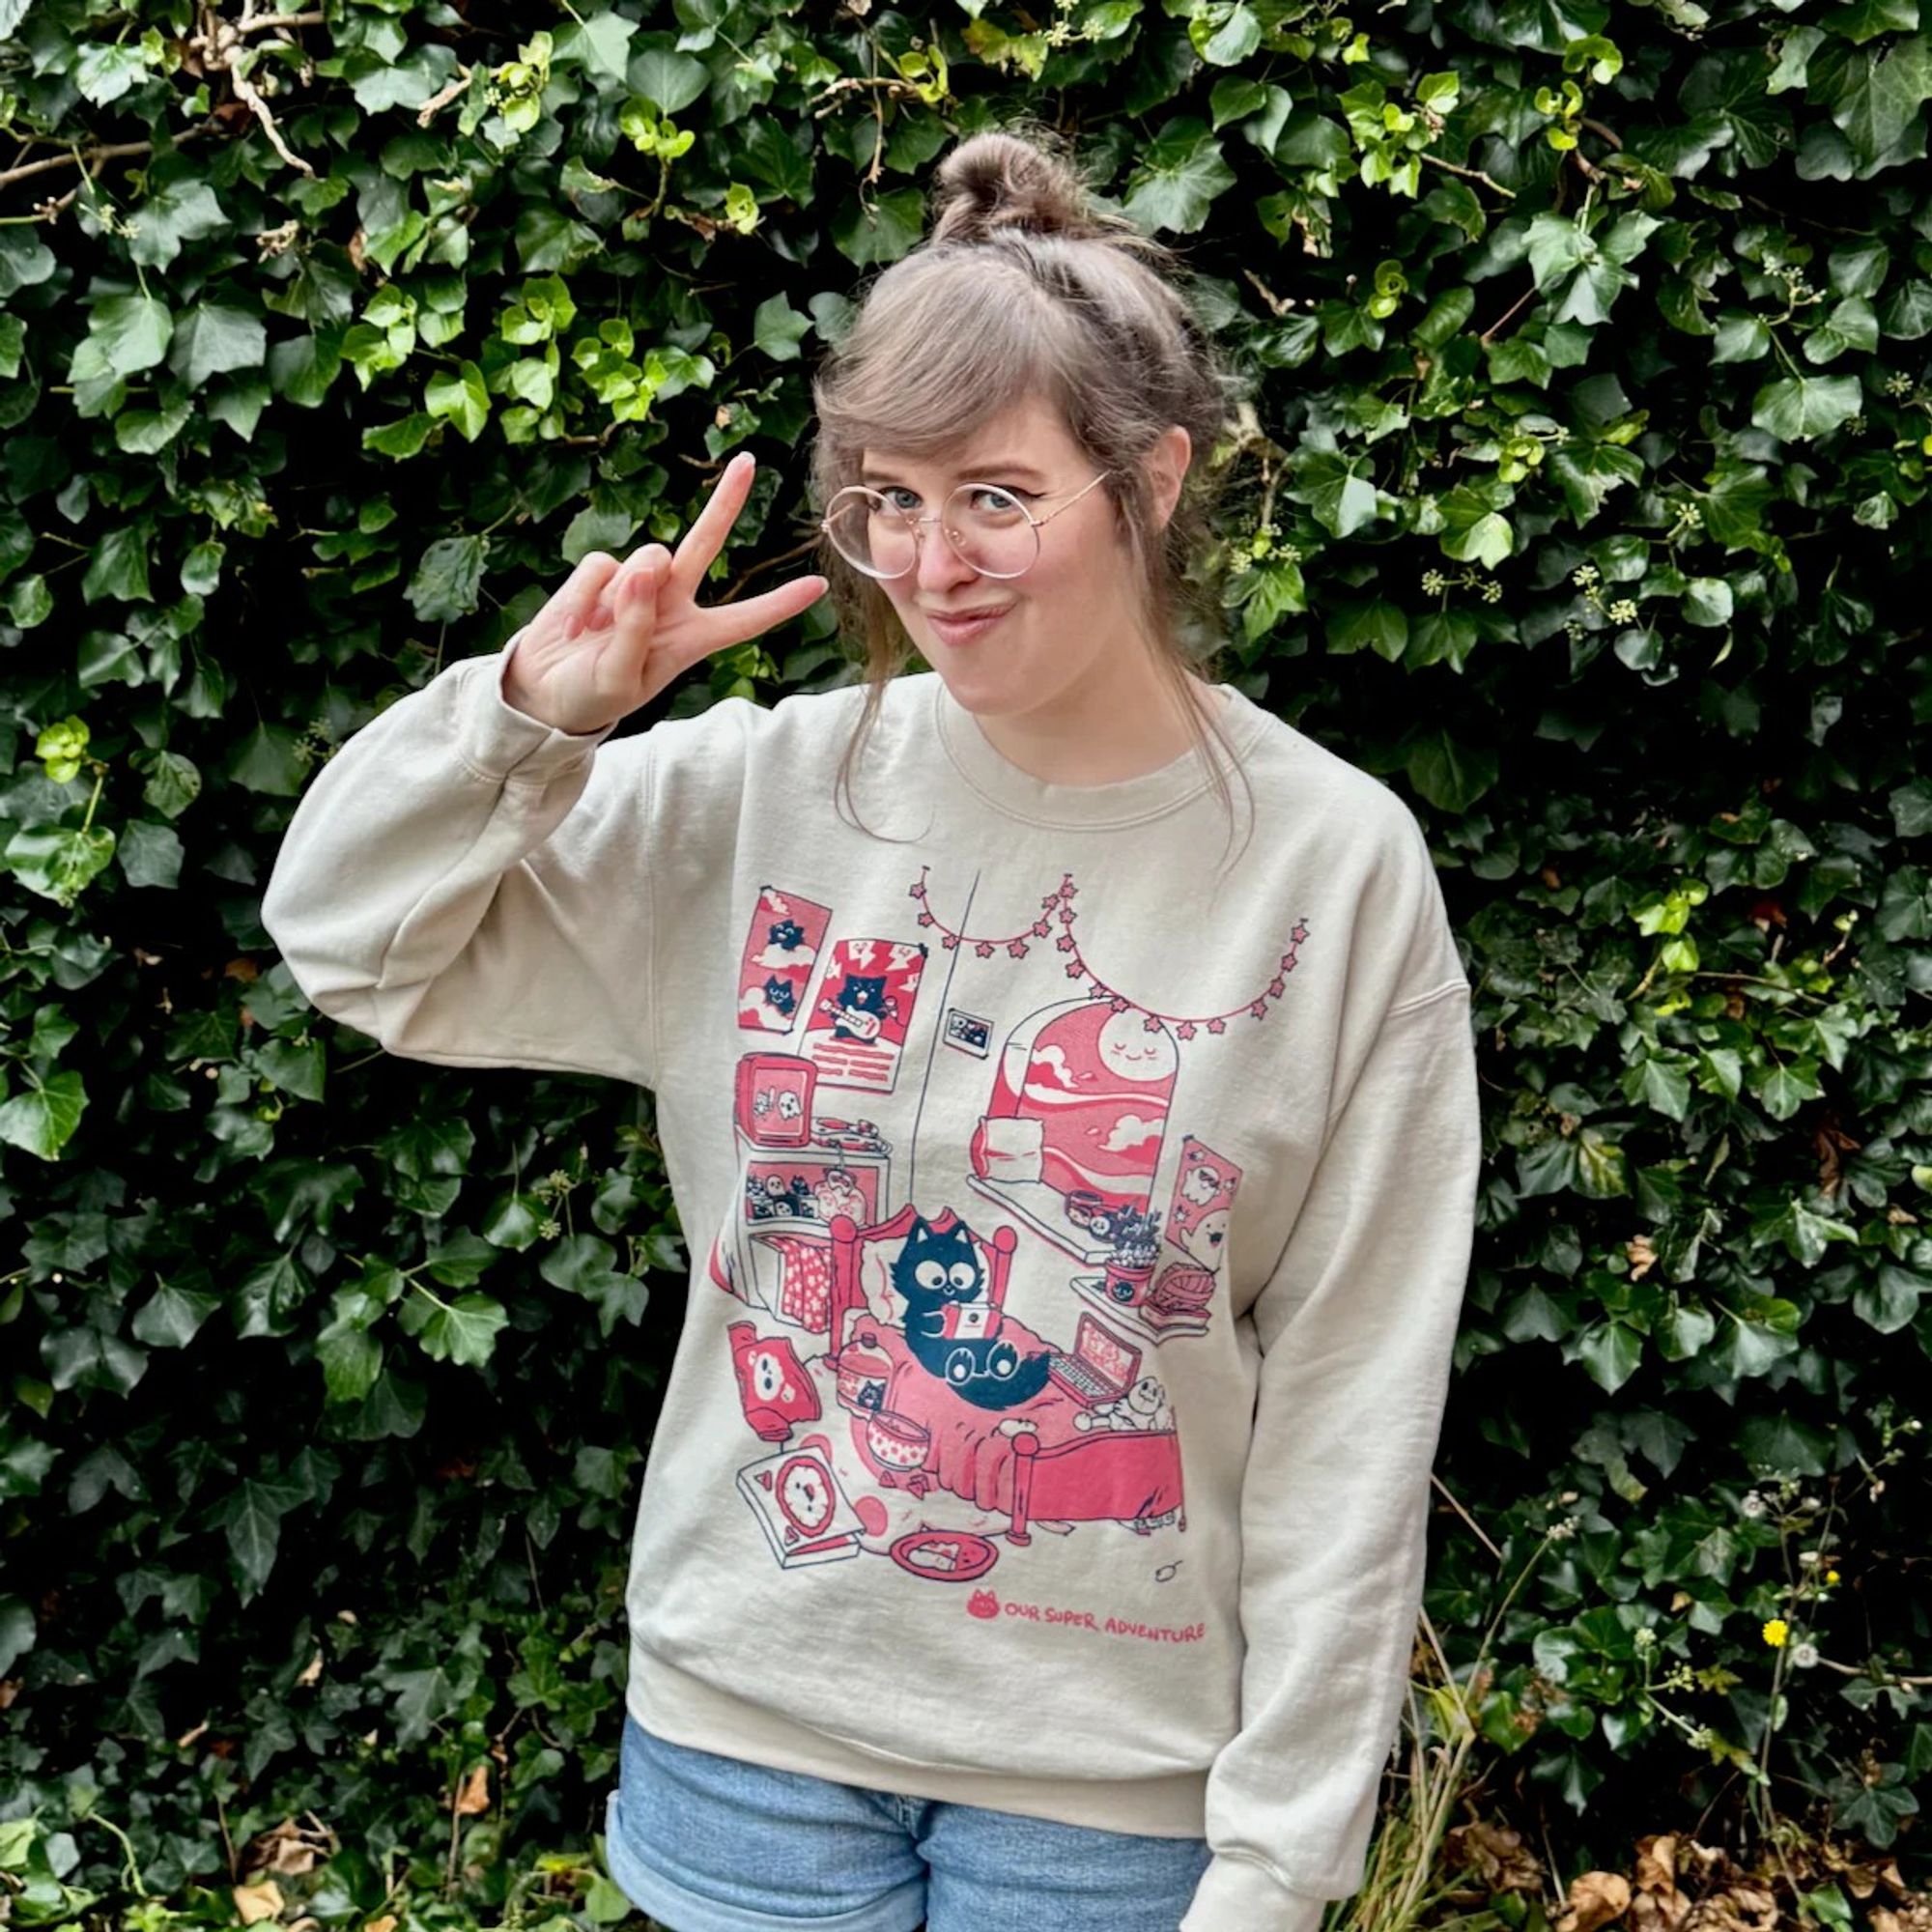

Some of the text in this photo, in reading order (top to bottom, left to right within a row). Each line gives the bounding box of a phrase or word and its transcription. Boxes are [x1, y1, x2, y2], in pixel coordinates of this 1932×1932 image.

[1005, 1603, 1205, 1642] OUR SUPER ADVENTURE
